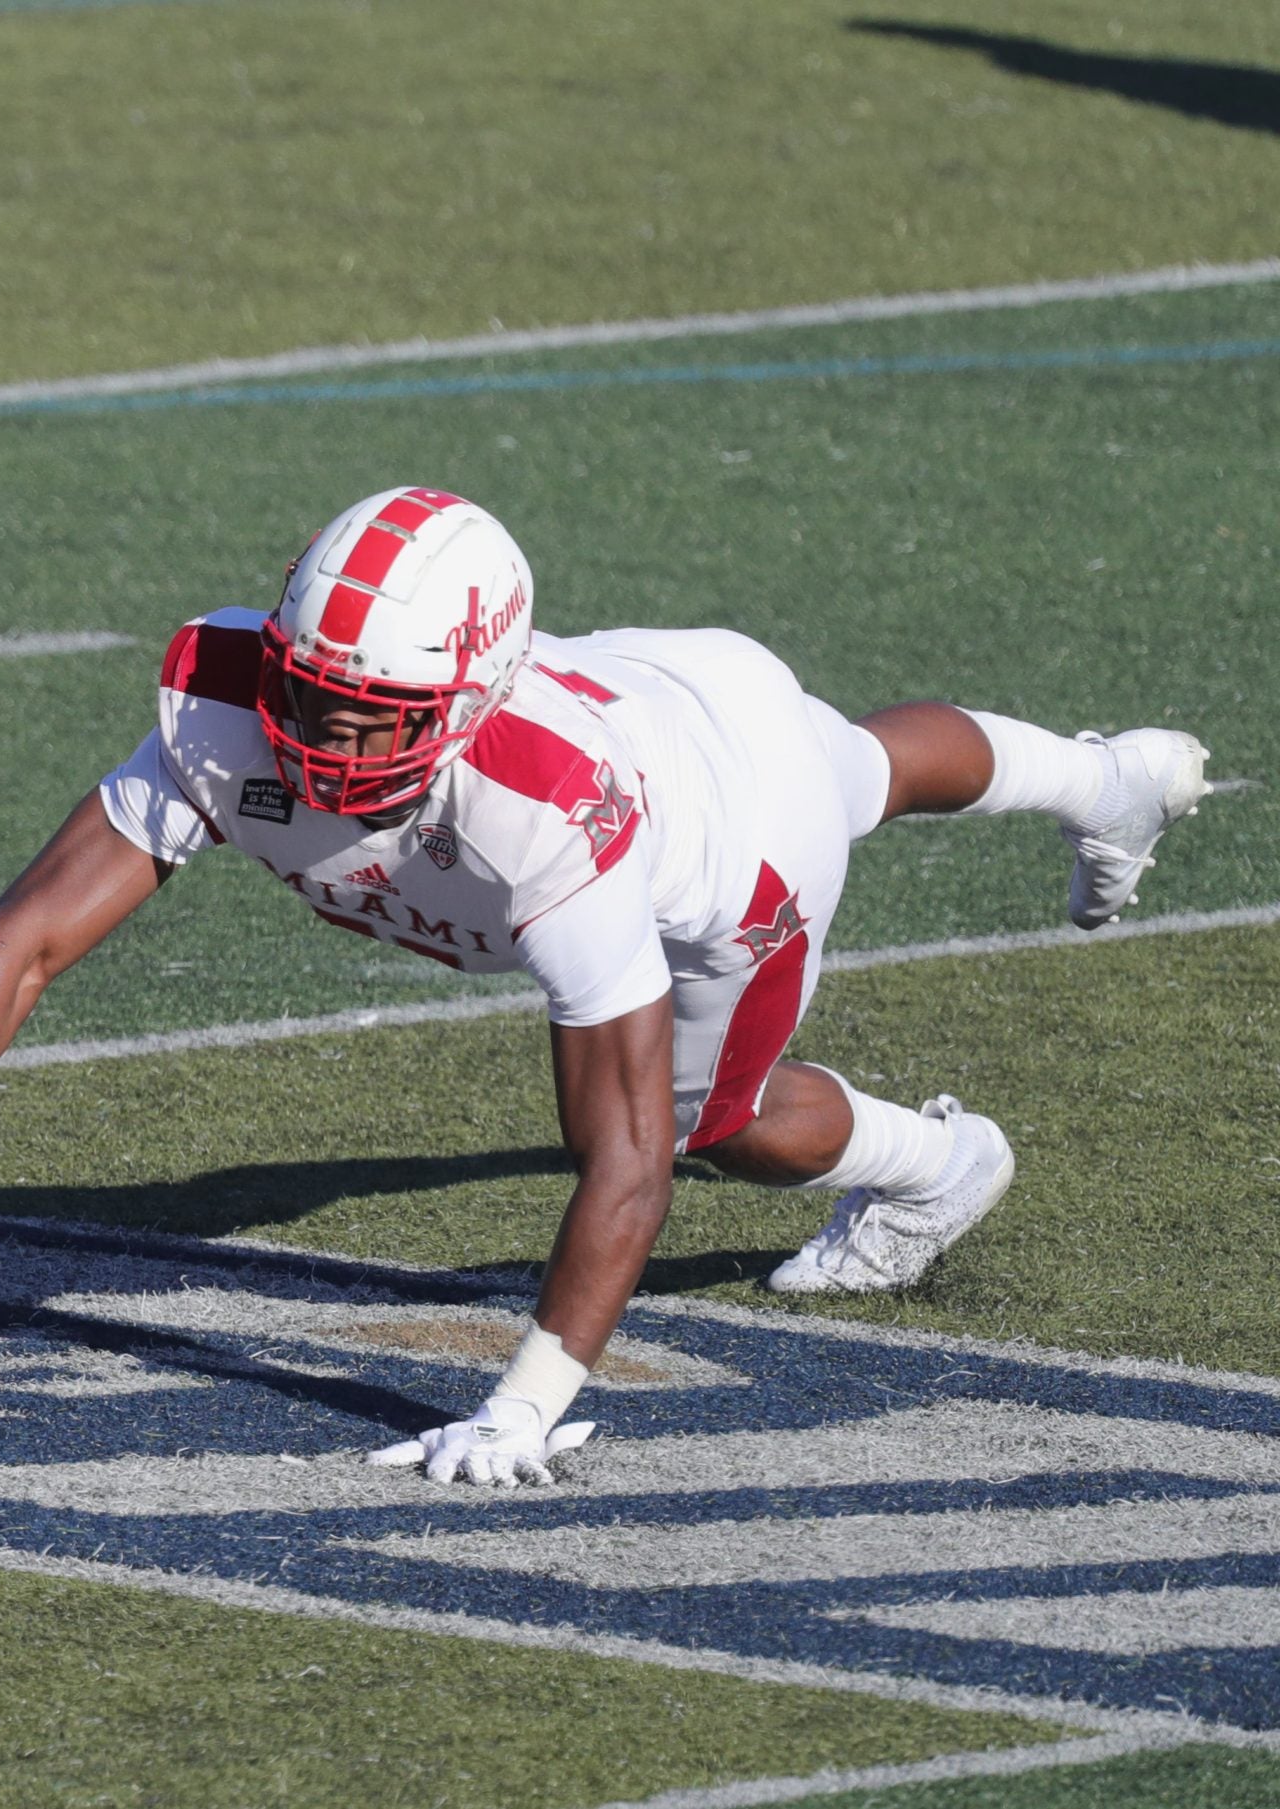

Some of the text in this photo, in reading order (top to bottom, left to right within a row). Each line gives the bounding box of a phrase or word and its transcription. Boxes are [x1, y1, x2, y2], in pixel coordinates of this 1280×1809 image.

[241, 803, 286, 818] minimum
[262, 794, 282, 807] the
[343, 872, 401, 897] adidas
[257, 856, 497, 955] MIAMI
